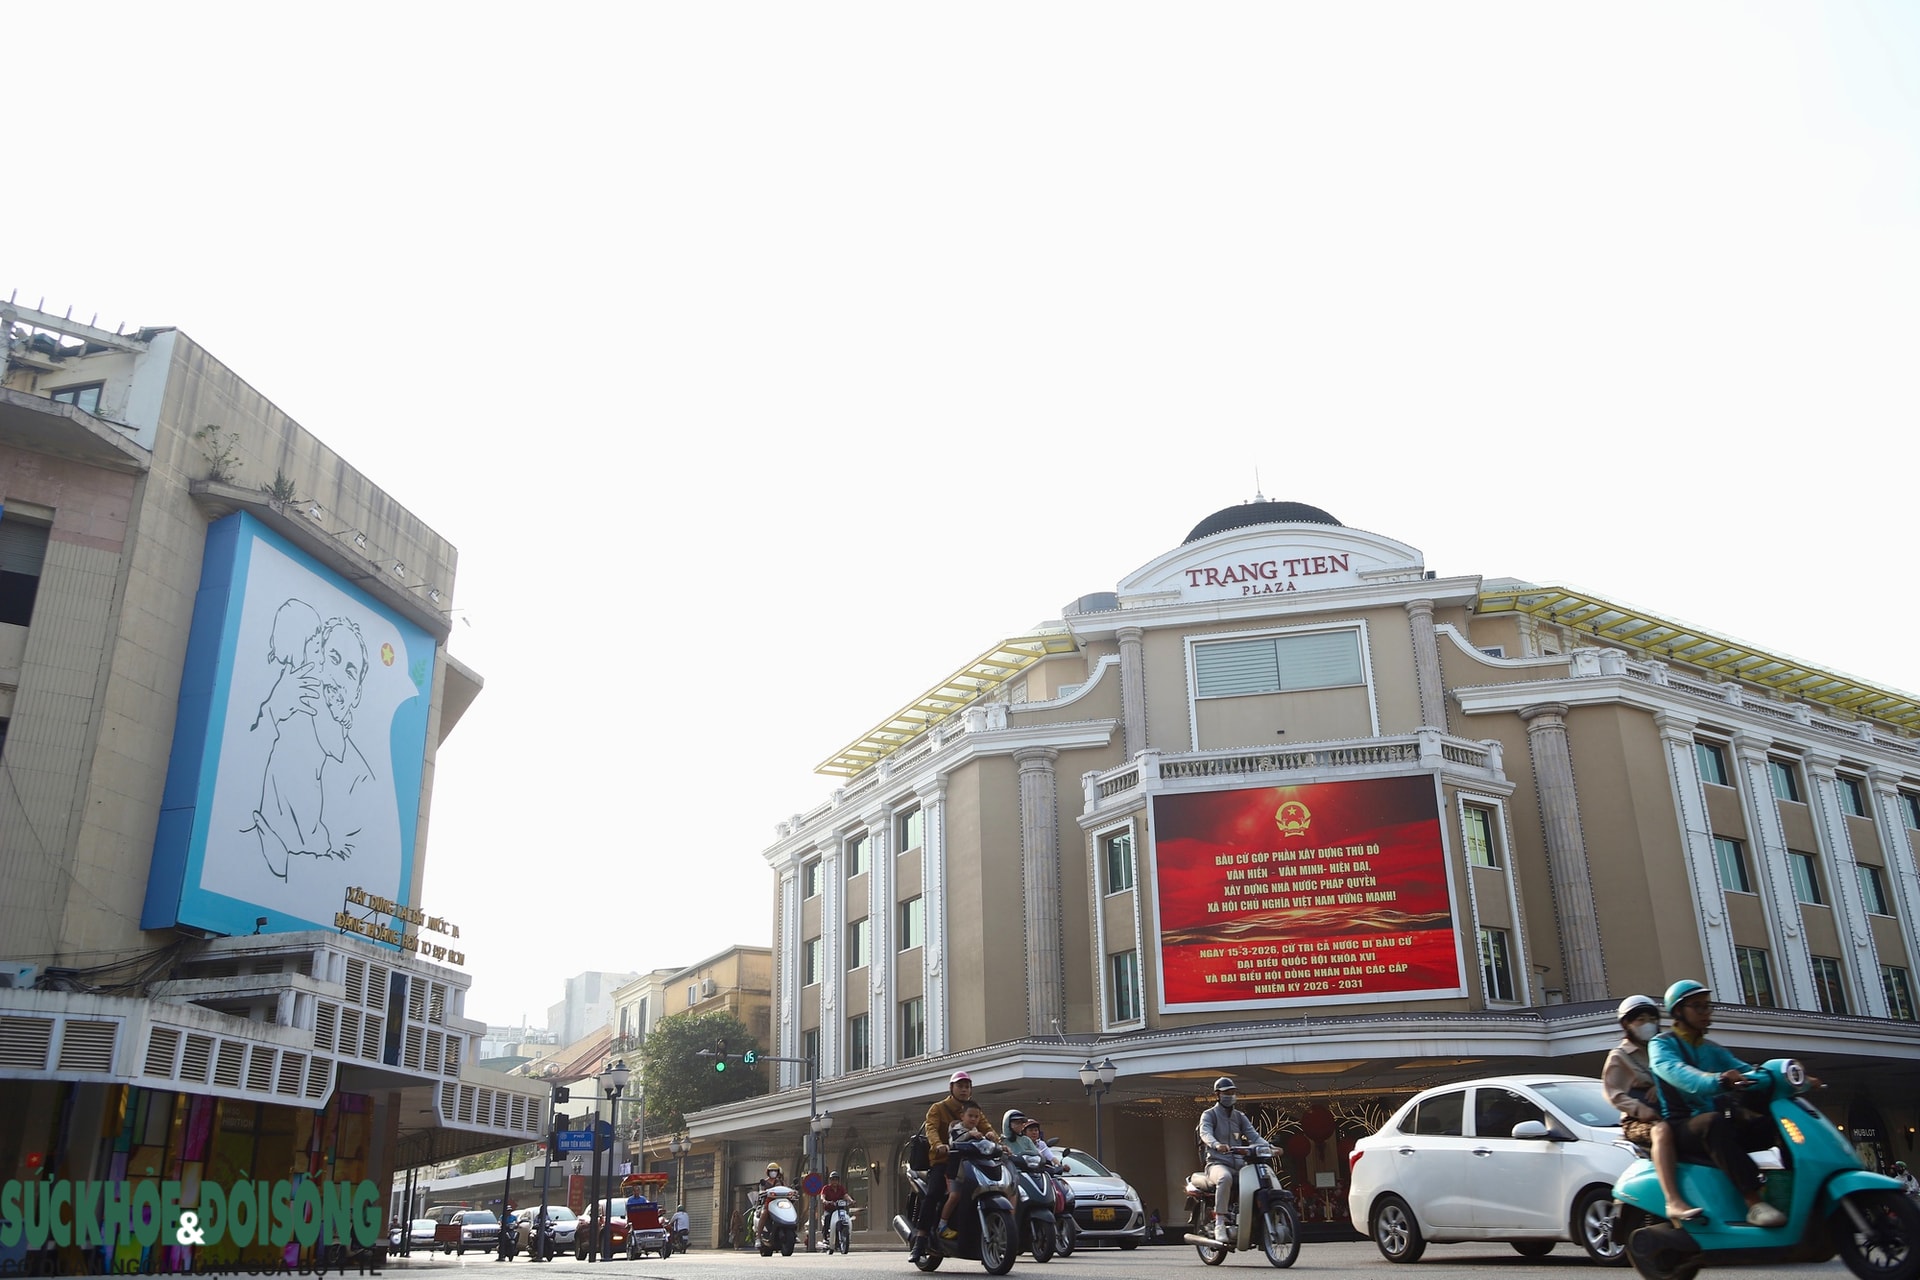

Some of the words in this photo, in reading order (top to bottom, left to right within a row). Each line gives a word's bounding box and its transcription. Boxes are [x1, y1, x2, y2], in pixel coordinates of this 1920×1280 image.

[1186, 560, 1278, 587] TRANG
[1283, 554, 1349, 577] TIEN
[1242, 582, 1296, 596] PLAZA
[1216, 853, 1233, 865] BẦU
[1236, 851, 1249, 864] CỬ
[1252, 852, 1269, 863] GÓP
[1272, 848, 1296, 862] PHẦN
[1298, 848, 1315, 860] XÂY
[1319, 846, 1343, 859] DỰNG
[1346, 844, 1364, 855] THỦ
[1367, 843, 1380, 855] ĐÔ
[1226, 869, 1244, 880] VĂN
[1248, 866, 1268, 878] HIẾN
[1279, 865, 1297, 877] VĂN
[1329, 861, 1350, 874] HIỆN
[1224, 884, 1241, 896] XÂY
[1244, 883, 1269, 896] DỰNG
[1272, 880, 1290, 893] NHÀ
[1293, 879, 1317, 891] NƯỚC
[1320, 878, 1344, 889] PHÁP
[1347, 873, 1376, 888] QUYỀN
[1208, 901, 1219, 912] XÃ
[1222, 900, 1238, 913] HỘI
[1241, 898, 1259, 910] CHỦ
[1262, 896, 1290, 909] NGHĨA
[1293, 895, 1312, 908] VIỆT
[1315, 893, 1335, 906] NAM
[1338, 891, 1363, 904] VỮNG
[1366, 891, 1396, 904] MẠNH!
[1200, 947, 1224, 958] NGÀY
[1282, 943, 1294, 954] CỬ
[1298, 944, 1313, 952] TRI
[1317, 939, 1330, 951] CẢ
[1333, 940, 1359, 950] NƯỚC
[1362, 940, 1373, 948] ĐI
[1376, 937, 1396, 948] BẦU
[1398, 937, 1412, 946] CỬ
[1237, 960, 1253, 969] ĐẠI
[1257, 956, 1278, 967] BIỂU
[1281, 954, 1307, 966] QUỐC
[1311, 954, 1328, 965] HỘI
[1360, 953, 1376, 961] XVI
[1205, 974, 1218, 983] VÀ
[1221, 974, 1236, 983] ĐẠI
[1240, 969, 1262, 981] BIỂU
[1265, 969, 1281, 980] HỘI
[1284, 967, 1310, 979] ĐỒNG
[1314, 966, 1340, 977] NHÂN
[1343, 966, 1362, 975] DÂN
[1366, 963, 1385, 974] CÁC
[1388, 961, 1408, 972] CẤP
[1254, 982, 1285, 994] NHIỆM
[1288, 981, 1302, 992] KỲ
[1304, 981, 1329, 991] 2026
[1339, 980, 1363, 988] 2031
[1853, 1128, 1876, 1136] HUBLOT
